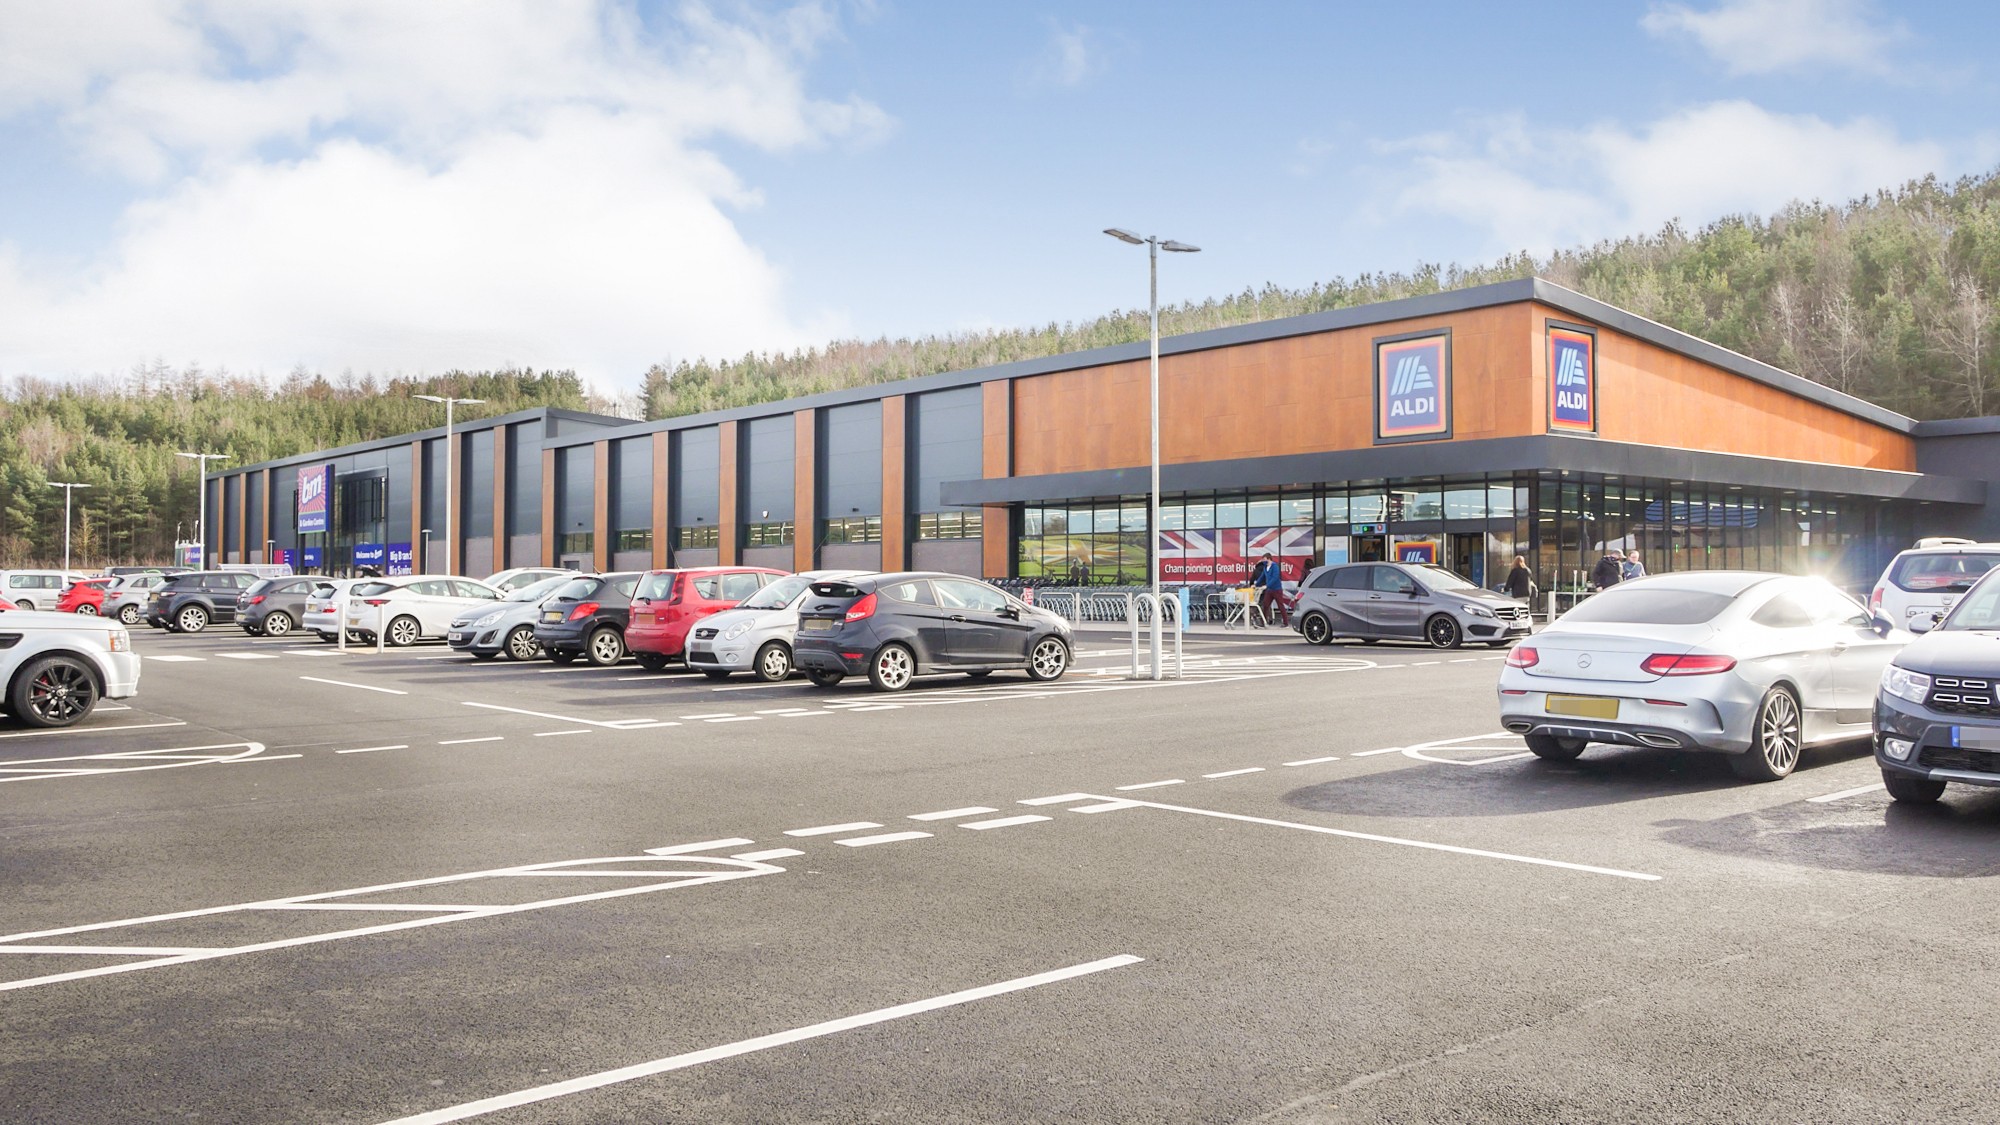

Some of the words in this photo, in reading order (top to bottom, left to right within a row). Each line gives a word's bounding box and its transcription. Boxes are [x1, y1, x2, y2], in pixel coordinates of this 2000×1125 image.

[1390, 396, 1435, 417] ALDI
[1557, 390, 1587, 411] ALDI
[390, 550, 398, 563] Big
[1164, 563, 1213, 576] Championing
[1216, 563, 1235, 573] Great
[1235, 562, 1256, 573] Briti
